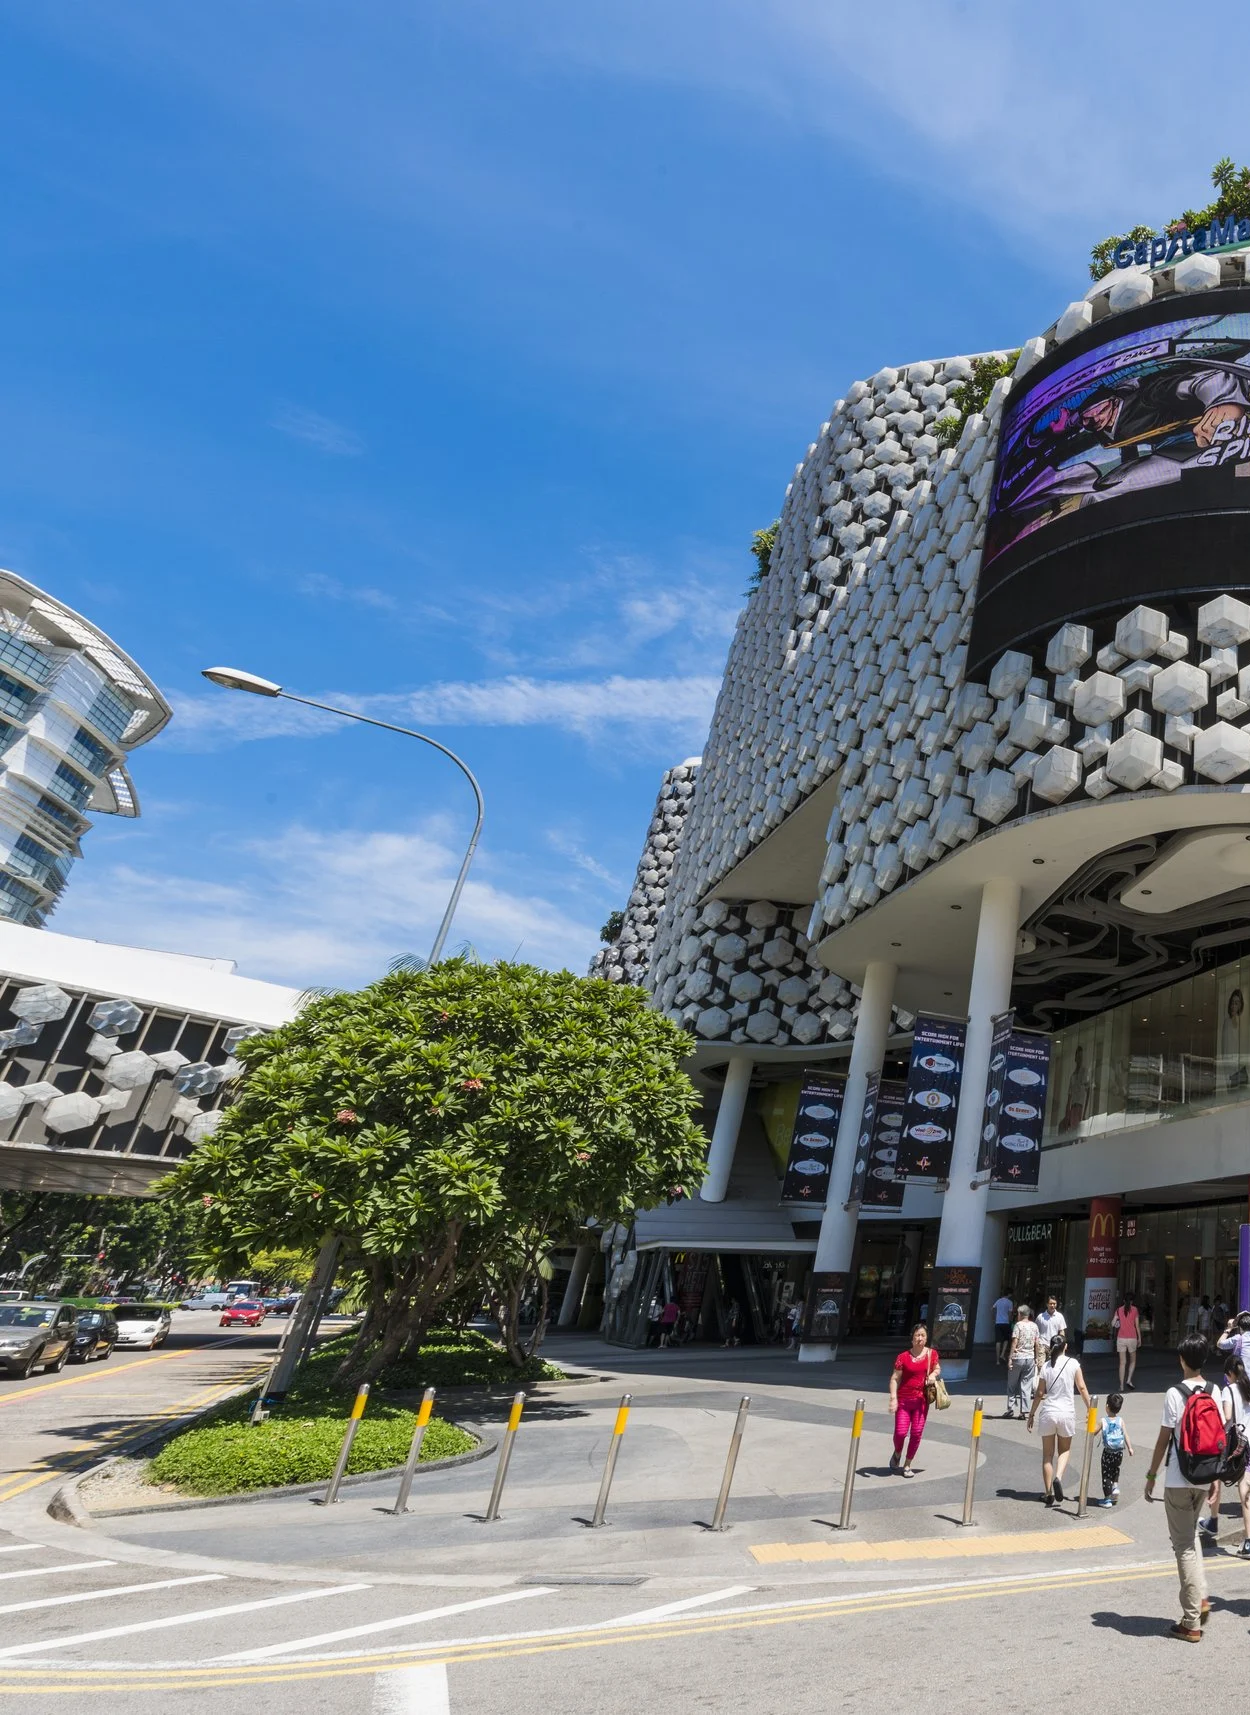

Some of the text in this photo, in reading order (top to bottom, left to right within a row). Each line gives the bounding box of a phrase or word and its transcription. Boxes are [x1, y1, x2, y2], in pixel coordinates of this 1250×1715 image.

[1124, 346, 1160, 362] DANCE
[914, 1036, 952, 1045] ENTERTAINMENT
[1008, 1224, 1052, 1242] PULL&BEAR
[1088, 1302, 1110, 1310] CHICK
